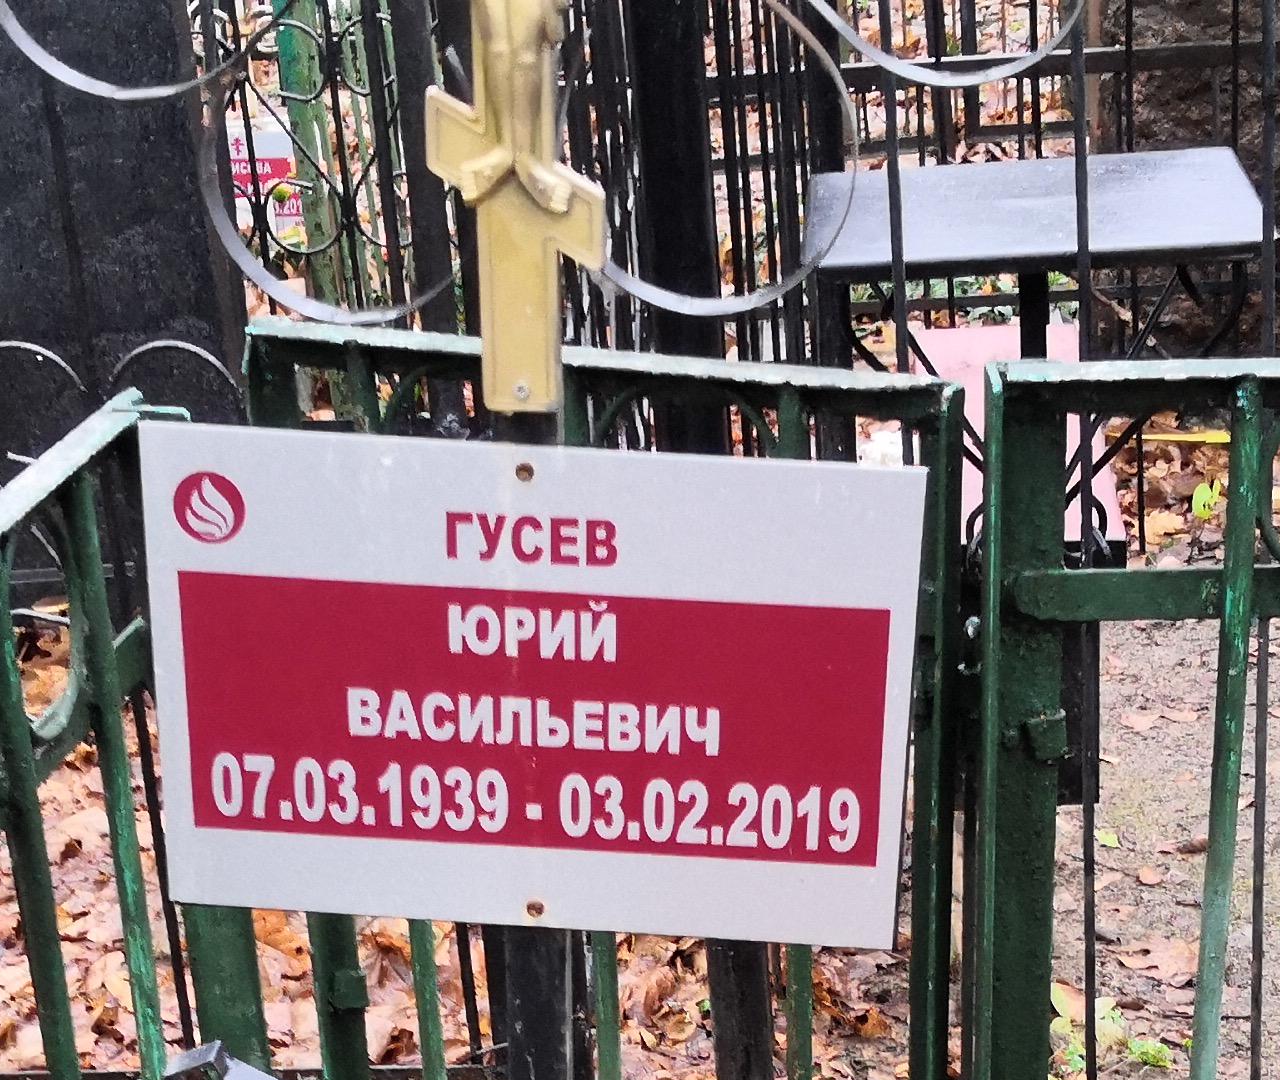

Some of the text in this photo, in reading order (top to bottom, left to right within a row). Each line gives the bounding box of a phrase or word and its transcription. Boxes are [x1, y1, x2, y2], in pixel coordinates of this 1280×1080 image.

[445, 511, 618, 567] ГУСЕВ
[448, 601, 618, 662] ЮРИЙ
[346, 686, 721, 757] ВАСИЛЬЕВИЧ
[211, 752, 862, 853] 07.03.1939 - 03.02.2019
